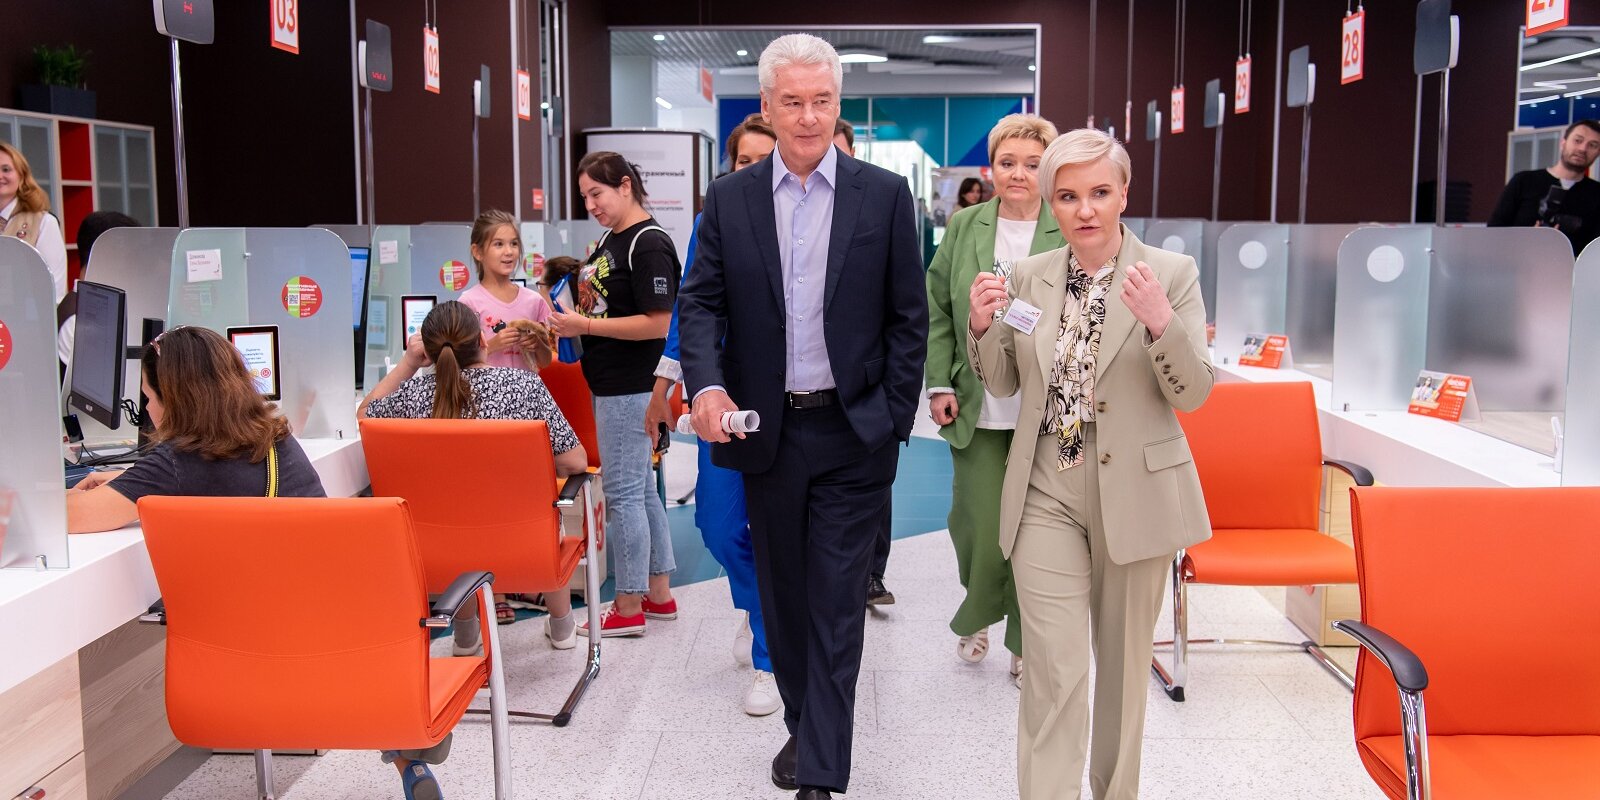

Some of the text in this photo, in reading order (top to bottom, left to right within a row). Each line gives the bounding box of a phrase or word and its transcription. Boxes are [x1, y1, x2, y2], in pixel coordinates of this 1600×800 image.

[276, 0, 296, 33] 03
[428, 45, 439, 78] 02
[1343, 29, 1360, 68] 28
[521, 83, 528, 107] 01
[1236, 73, 1248, 101] 29
